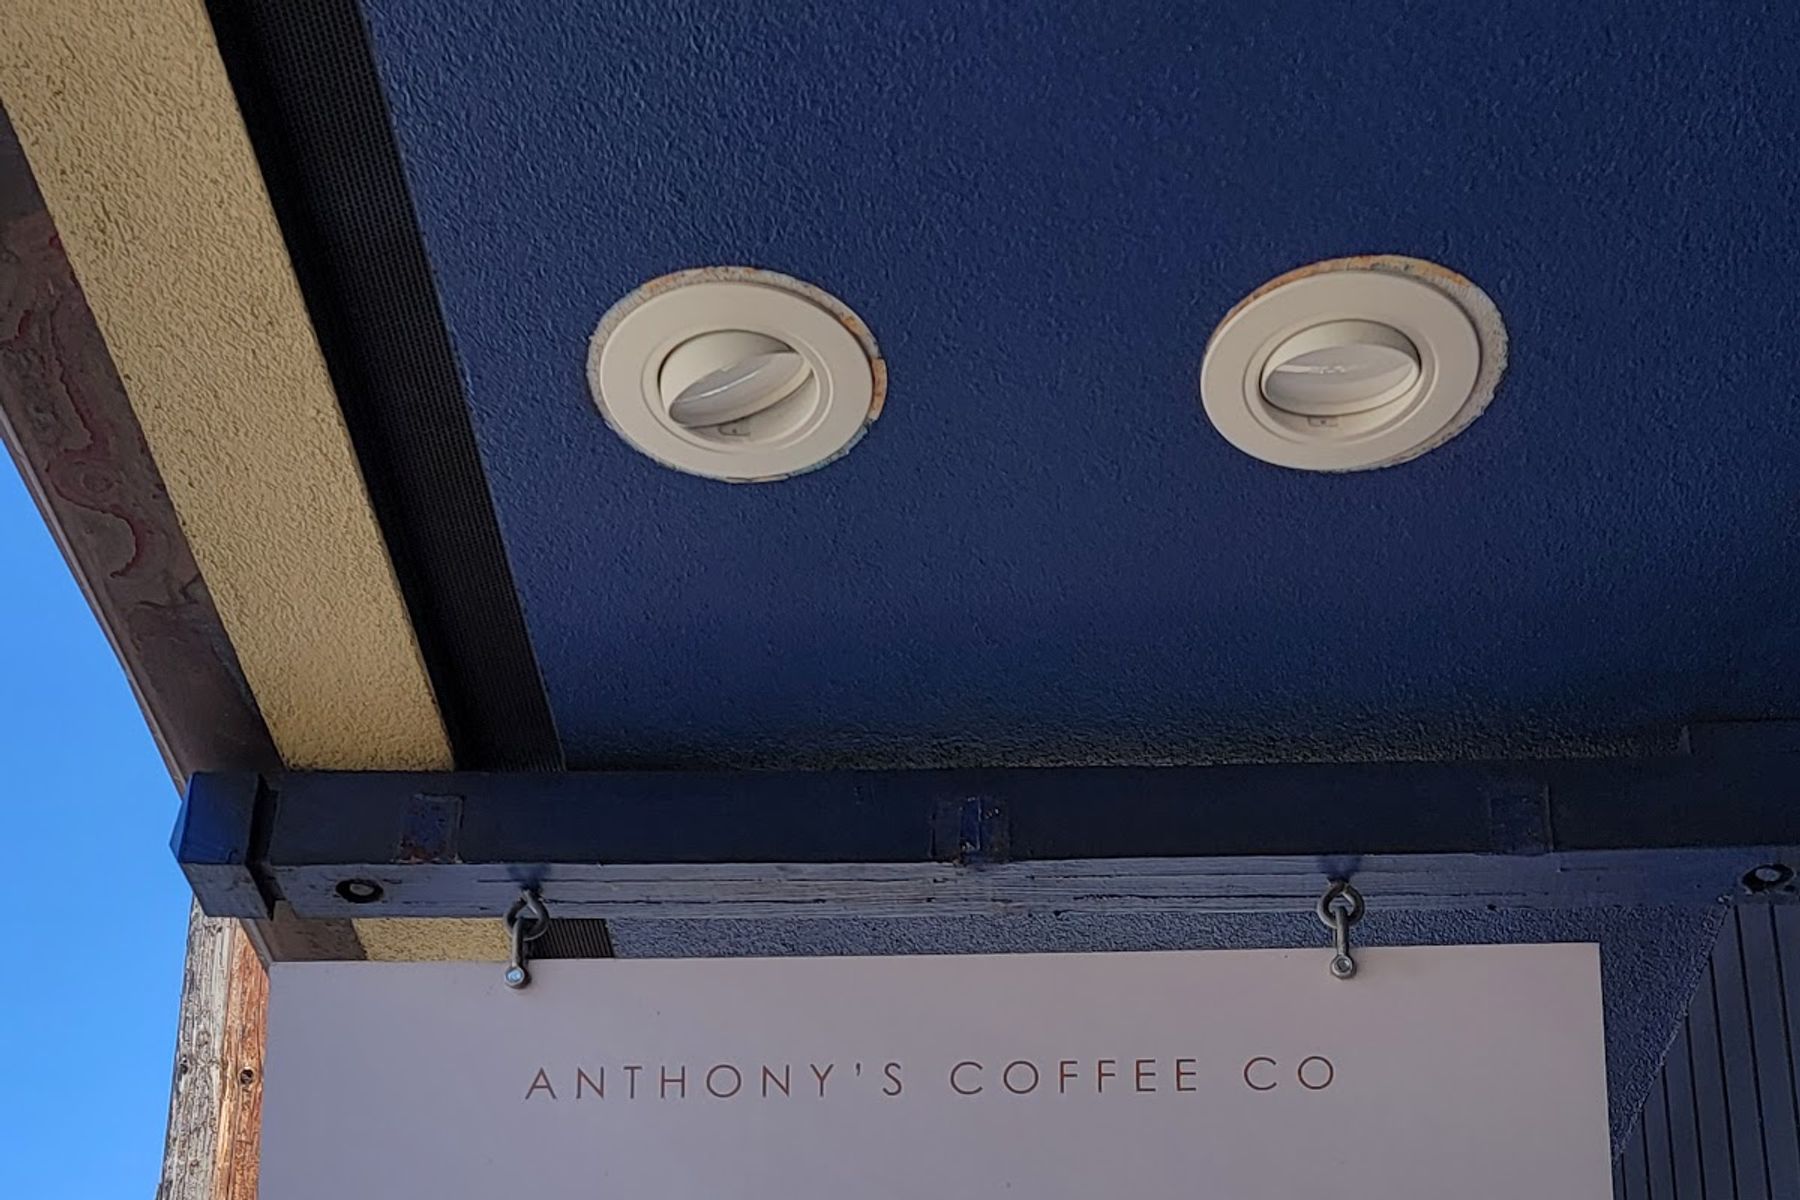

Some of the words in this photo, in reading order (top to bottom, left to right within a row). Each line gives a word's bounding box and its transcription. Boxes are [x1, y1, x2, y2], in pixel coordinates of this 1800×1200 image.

[525, 1062, 903, 1100] ANTHONY'S
[950, 1058, 1198, 1095] COFFEE
[1243, 1055, 1335, 1091] CO
